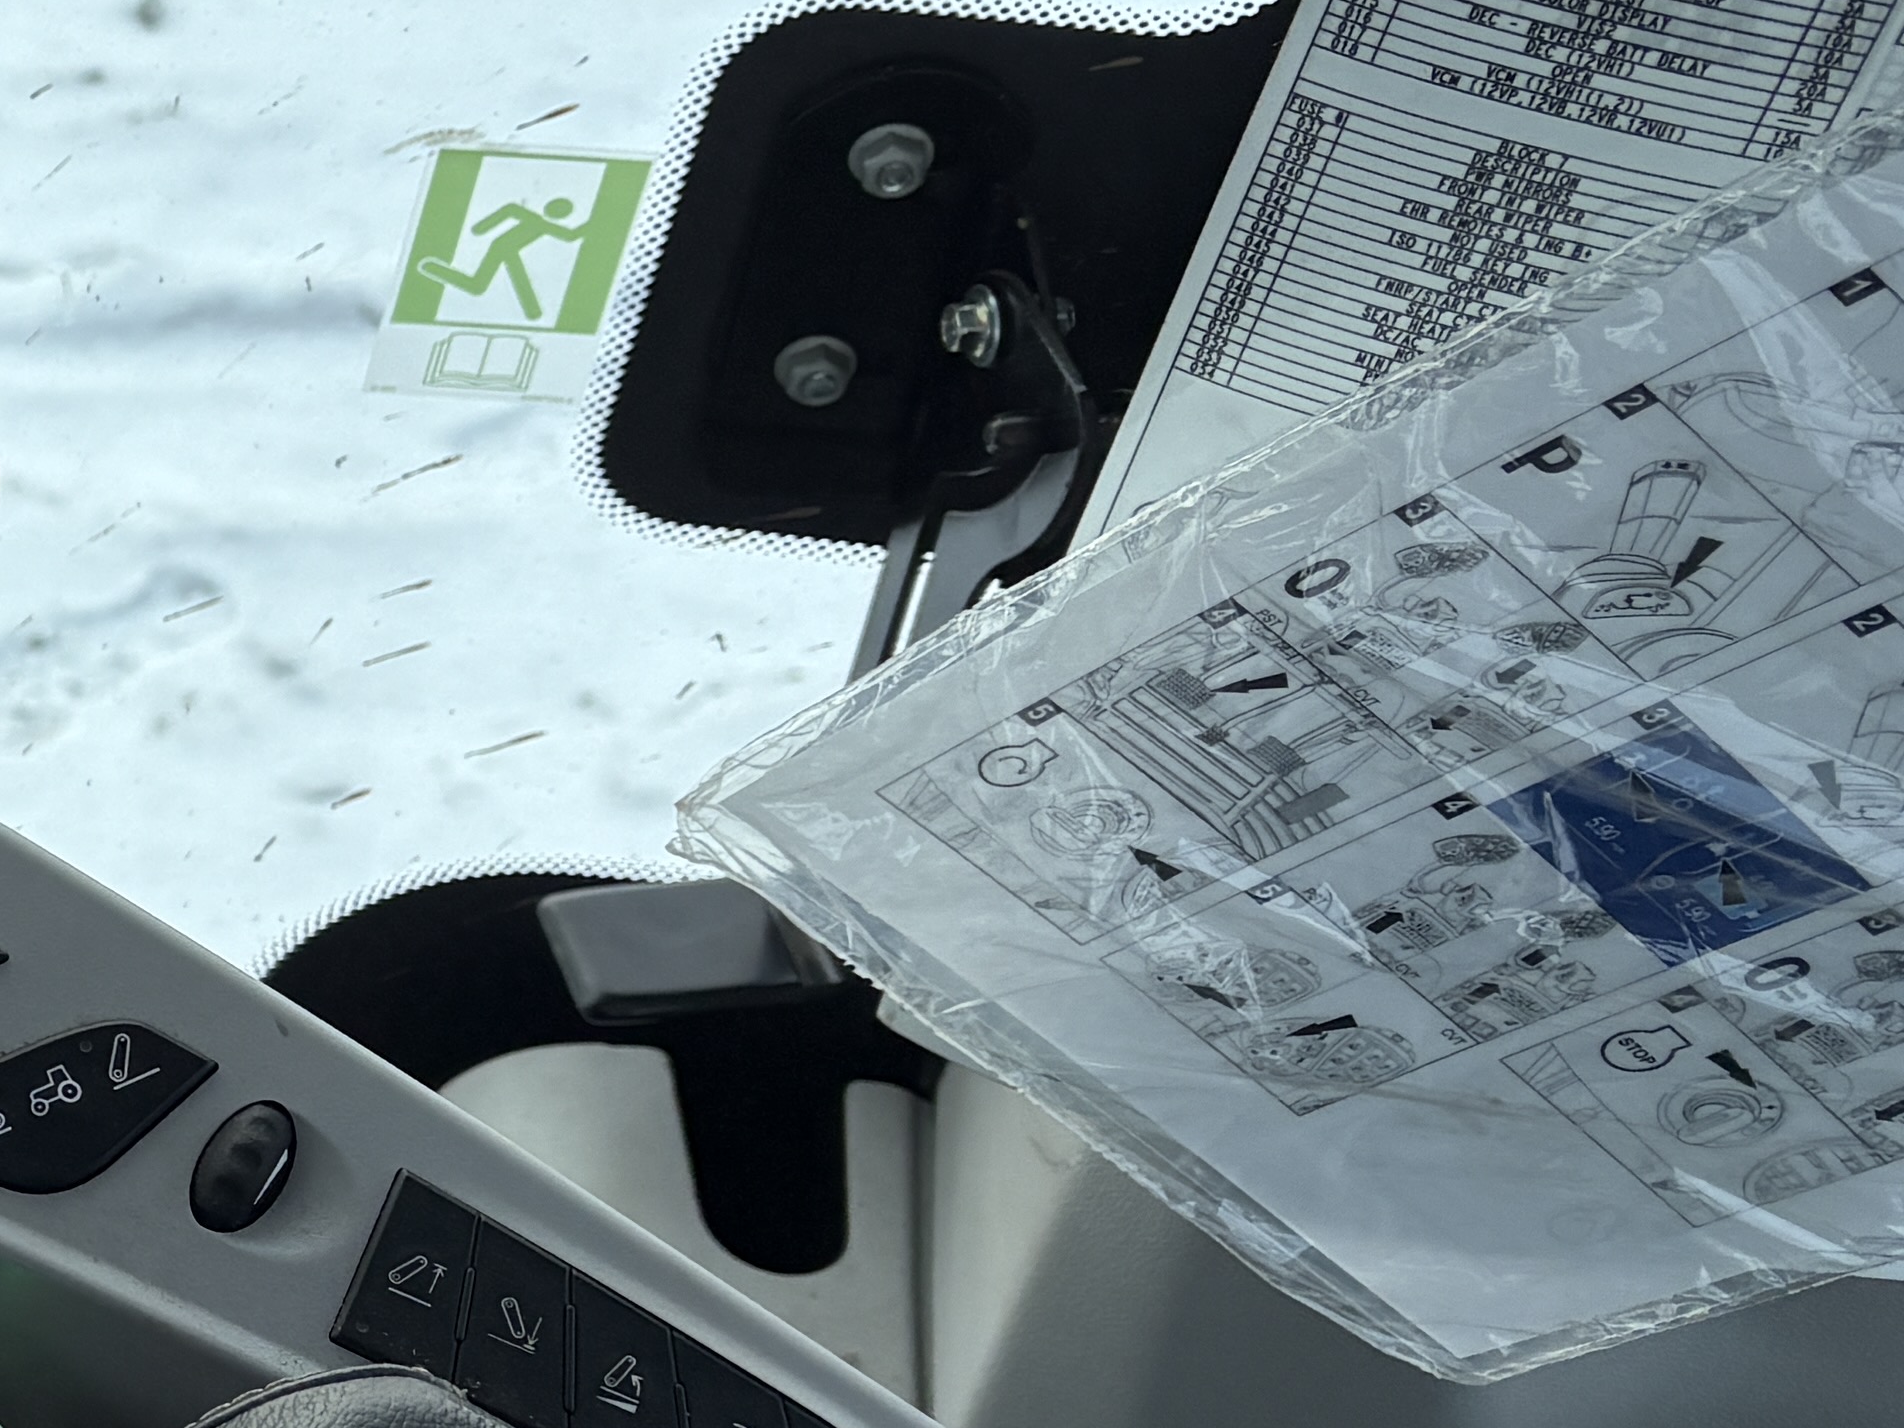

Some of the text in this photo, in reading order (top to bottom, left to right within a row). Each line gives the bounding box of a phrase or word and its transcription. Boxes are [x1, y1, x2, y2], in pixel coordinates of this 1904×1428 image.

[1597, 2, 1671, 30] DISPLAY
[1467, 7, 1710, 76] DEC REVERSE BATT DELAY
[1524, 39, 1636, 77] DEC (12VH1)
[1428, 68, 1461, 86] VCM
[1483, 64, 1516, 83] VCM
[1550, 63, 1594, 85] OPEN
[1287, 96, 1327, 119] FUSE
[1496, 140, 1549, 164] BLOCK
[1470, 152, 1581, 189] DESCRIPTION
[1463, 167, 1574, 205] PWR MIRRORS
[1436, 177, 1586, 224] FRONT INT WIPER
[1399, 201, 1431, 219] EHR
[1437, 210, 1507, 238] REMOTES
[1533, 235, 1565, 253] ING
[1453, 198, 1554, 234] REAR WIPER
[1448, 231, 1529, 261] NOT USED
[1387, 232, 1550, 284] ISO 11786 KEY ING
[1420, 257, 1529, 295] FUEL SENDER
[1847, 276, 1871, 298] 1
[1446, 280, 1488, 301] OPEN
[1360, 305, 1399, 325] SEAT
[1405, 302, 1444, 322] SEAT
[1372, 325, 1422, 348] DC/AC
[1616, 392, 1645, 413] 2
[1407, 501, 1432, 522] 3
[1255, 607, 1284, 628] PST
[1858, 610, 1885, 632] 2
[1355, 688, 1381, 707] CVT
[1030, 701, 1053, 721] 5
[1642, 706, 1670, 725] 3
[1443, 797, 1469, 815] 4
[1395, 963, 1421, 983] CVT
[1440, 1026, 1467, 1047] CVT
[1617, 1035, 1659, 1067] STOP
